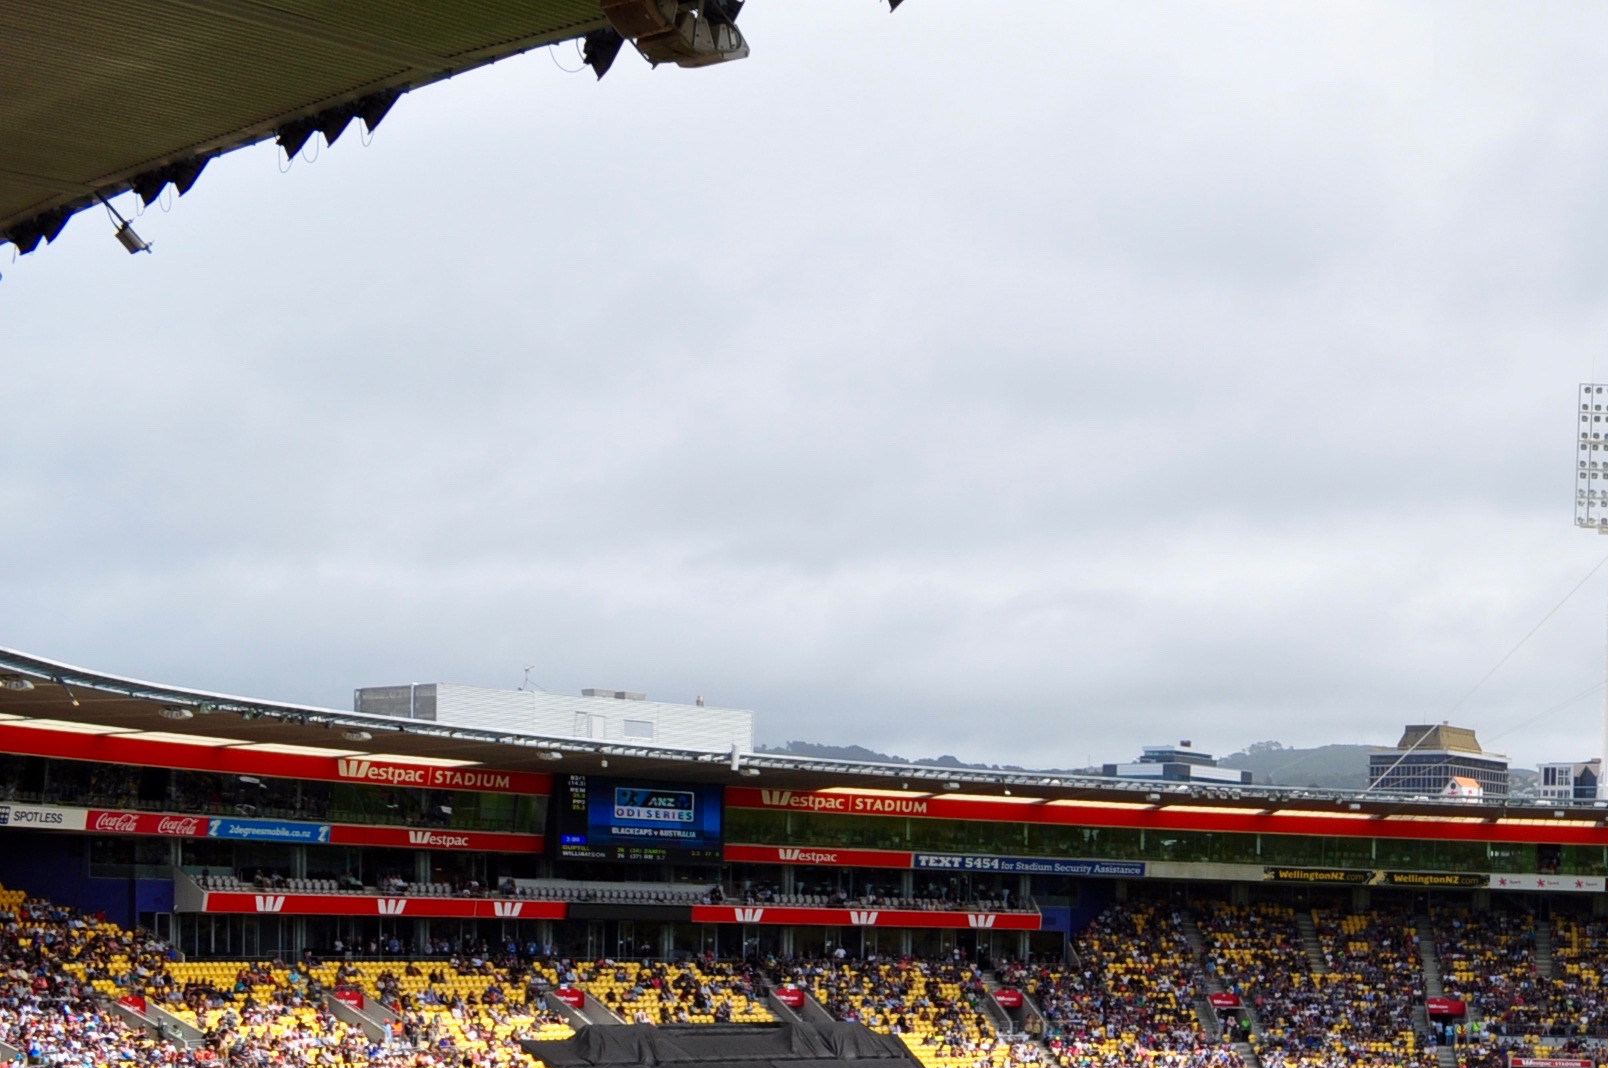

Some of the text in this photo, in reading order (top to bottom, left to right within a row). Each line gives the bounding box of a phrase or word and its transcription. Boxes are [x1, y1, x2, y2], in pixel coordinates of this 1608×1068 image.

[338, 759, 510, 788] Westpac STADIUM
[648, 797, 675, 807] ANZ
[761, 789, 927, 813] Westpac STADIUM
[13, 811, 63, 824] SPOTLESS
[616, 808, 693, 820] ODI SERIES
[228, 824, 311, 838] 2degreesmobile.co.nz
[659, 829, 696, 838] AUSTRALIA
[408, 830, 469, 847] Westpac
[778, 848, 837, 863] Westpac
[918, 855, 962, 867] TEXT
[964, 857, 999, 869] 5454
[1001, 861, 1014, 870] for
[1015, 861, 1052, 872] Stadium
[1053, 862, 1091, 875] Security
[1093, 864, 1141, 875] Assistance
[1279, 870, 1364, 884] WellingtonNZ.com
[1394, 874, 1479, 885] WellingtonNZ.com
